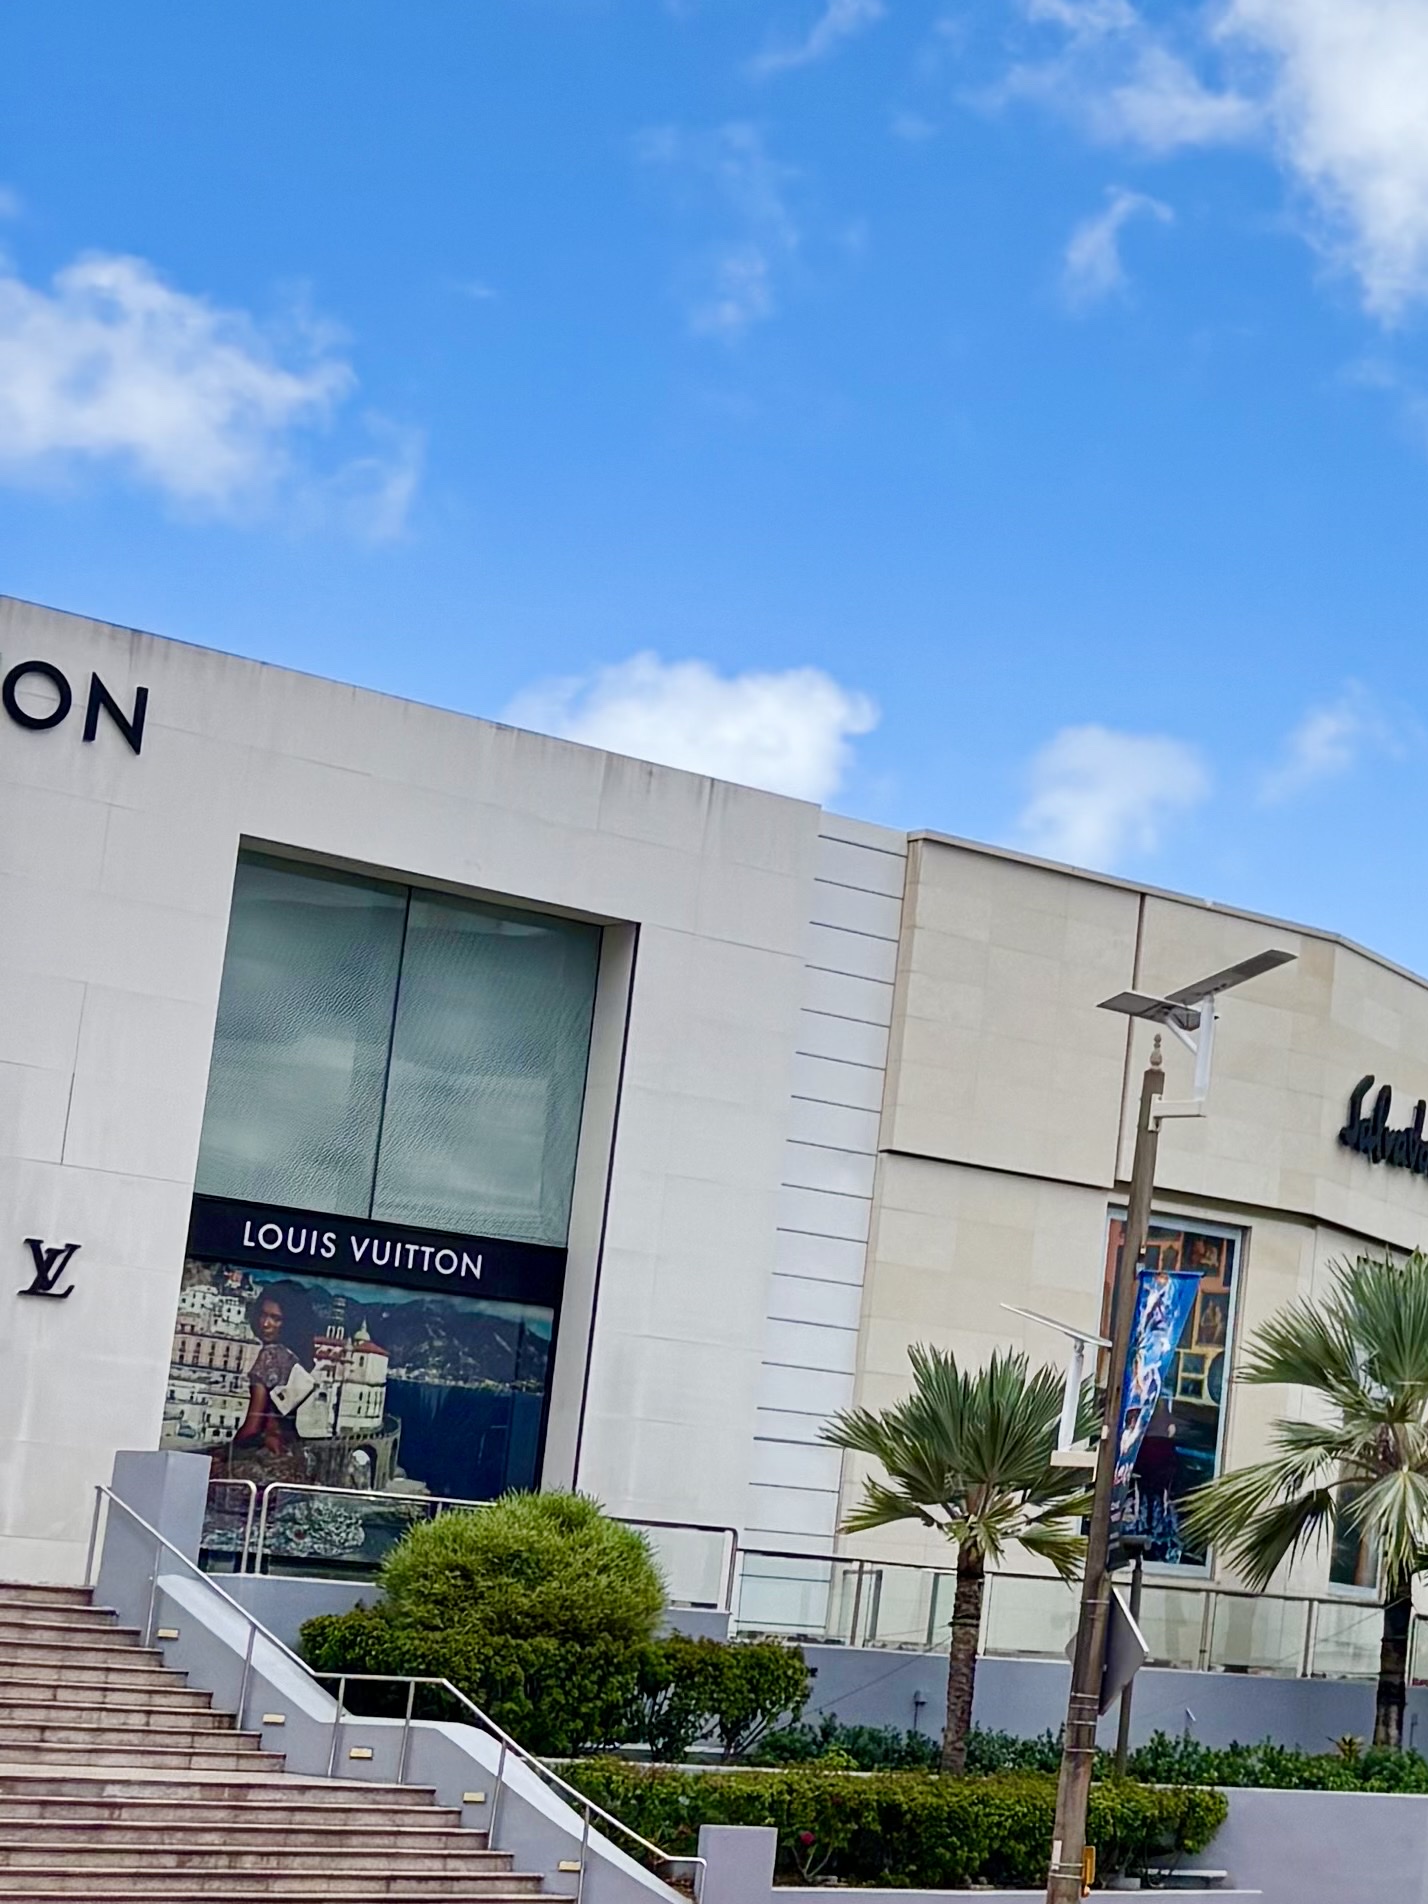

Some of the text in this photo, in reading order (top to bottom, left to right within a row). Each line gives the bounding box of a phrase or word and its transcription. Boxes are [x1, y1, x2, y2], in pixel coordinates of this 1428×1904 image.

[1, 660, 149, 756] ON
[243, 1221, 483, 1280] LOUIS VUITTON
